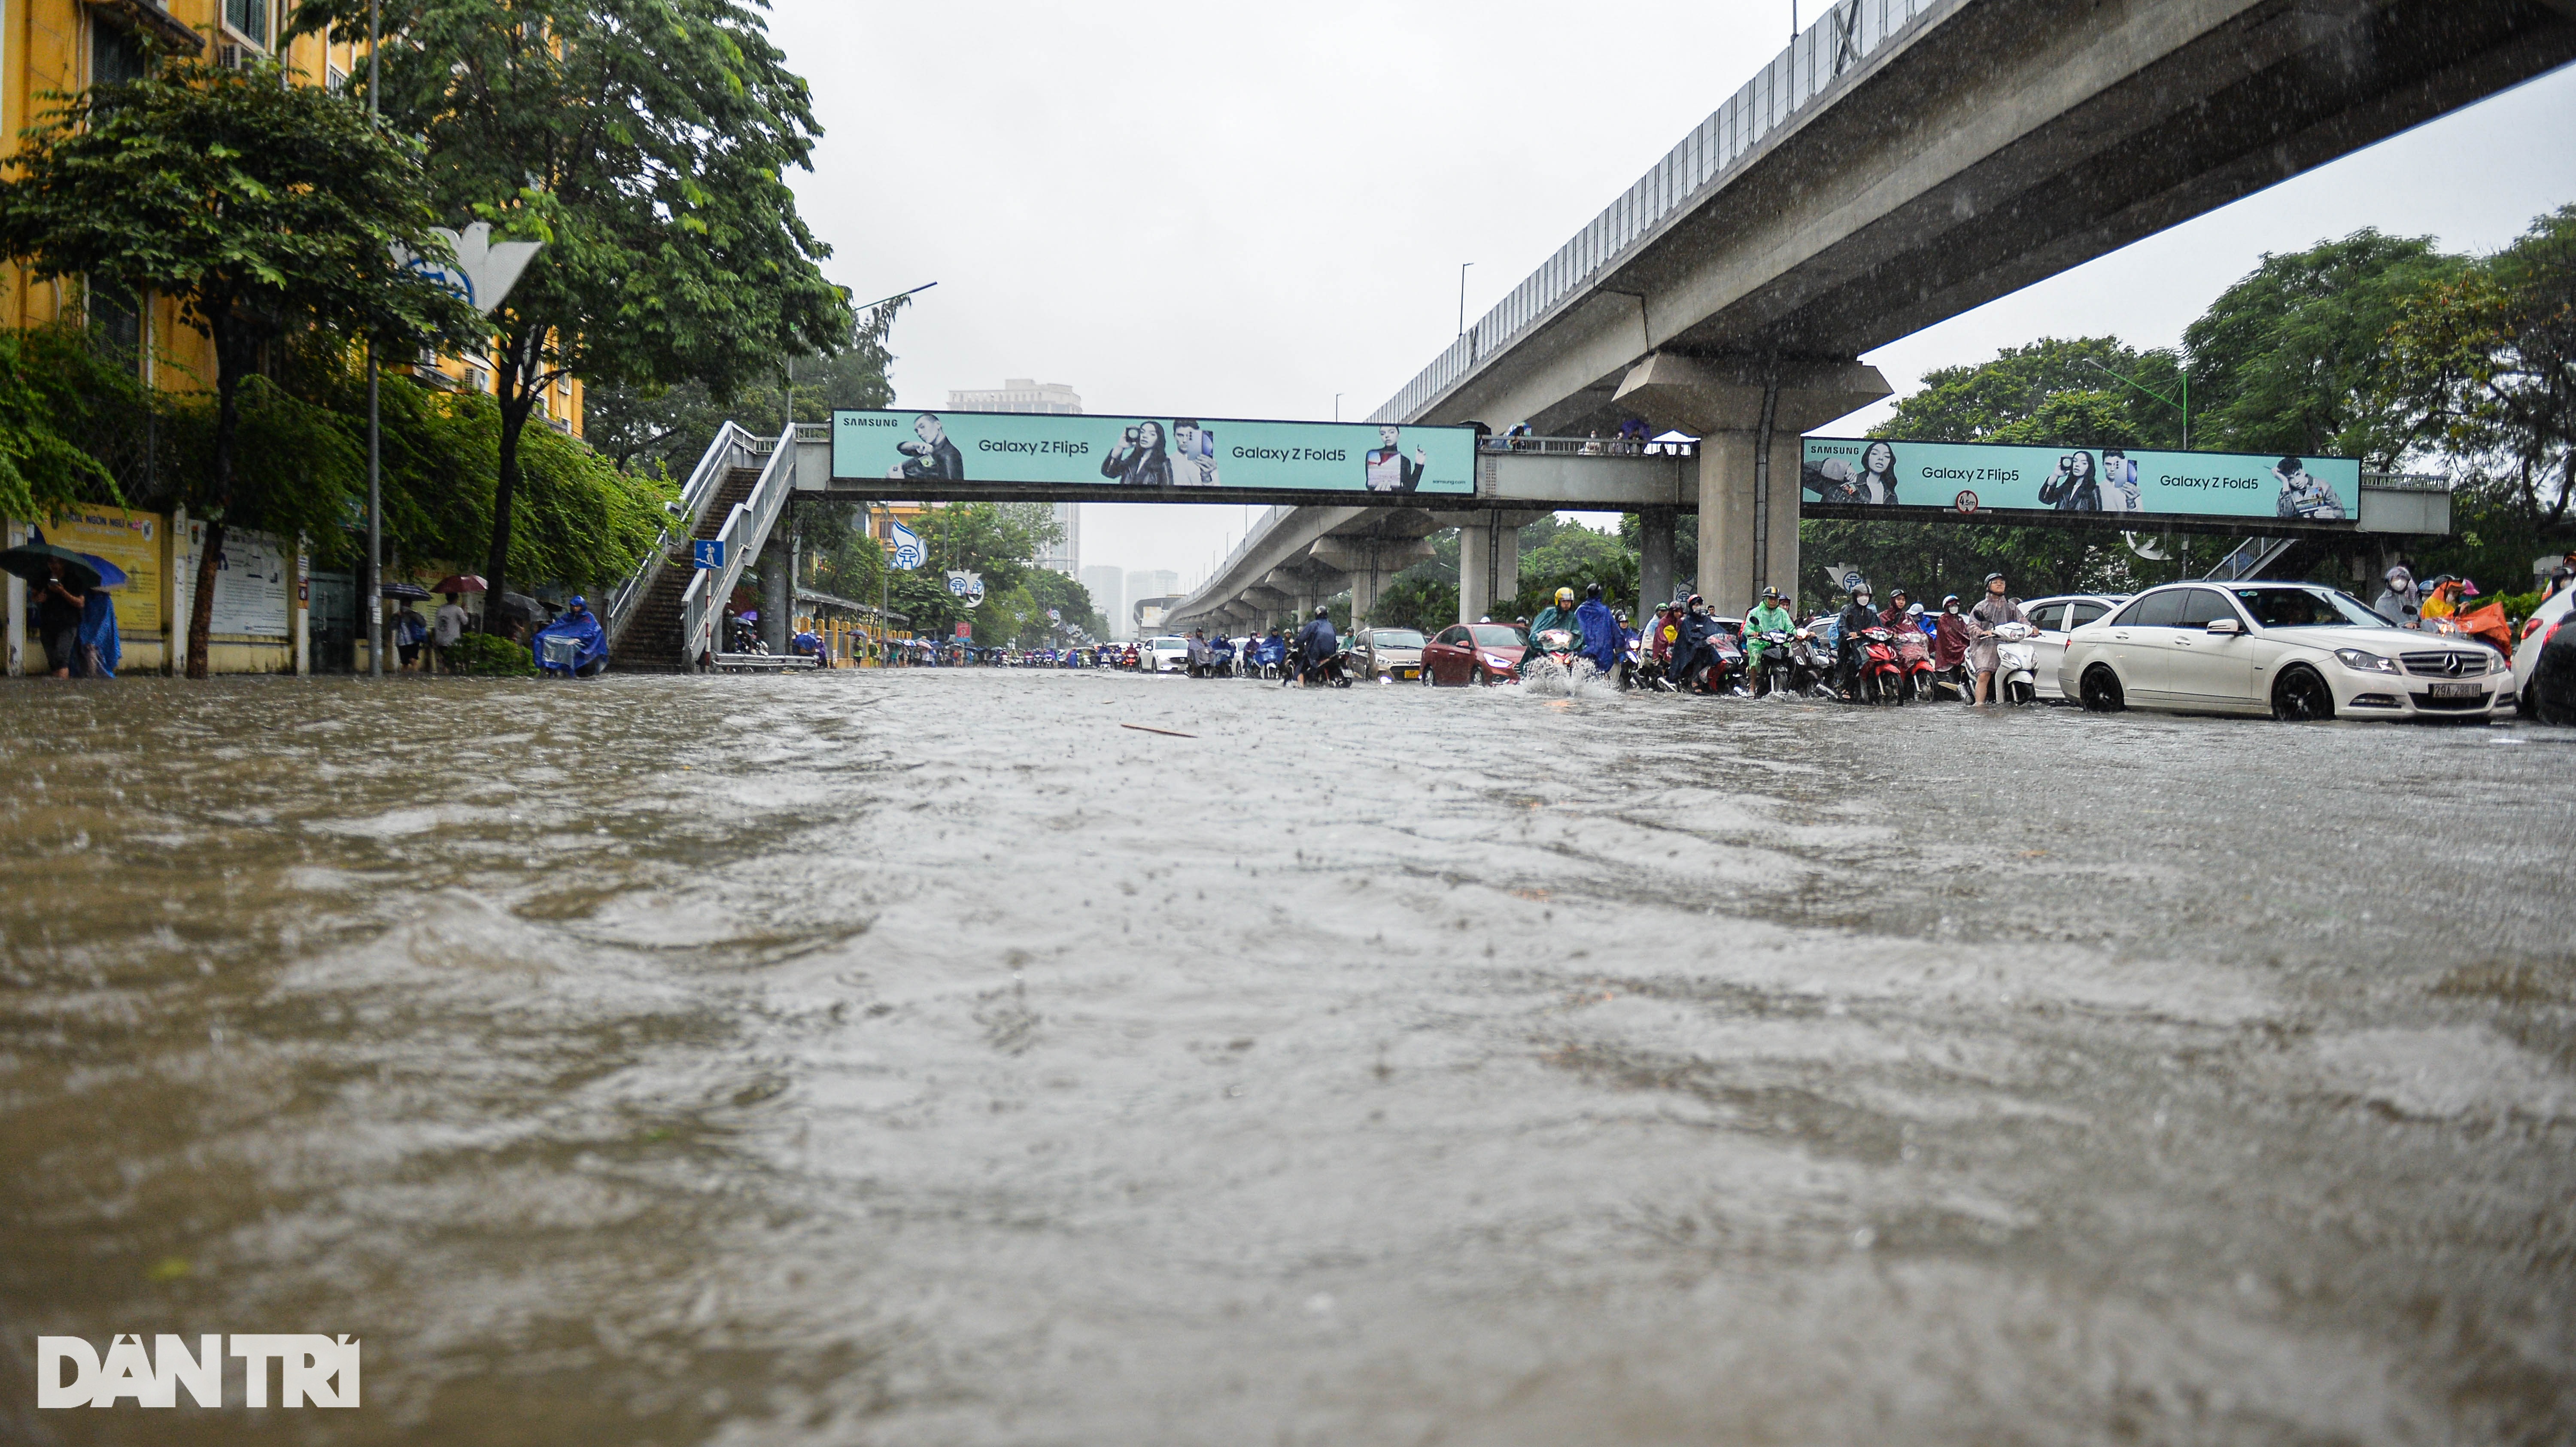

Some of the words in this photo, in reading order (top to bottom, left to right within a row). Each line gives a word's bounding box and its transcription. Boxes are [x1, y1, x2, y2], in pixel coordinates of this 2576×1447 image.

[844, 418, 897, 427] SAMSUNG
[979, 440, 1037, 455] Galaxy
[1041, 441, 1049, 453] Z
[1053, 441, 1088, 457] Flip5
[1233, 447, 1288, 462] Galaxy
[1292, 448, 1300, 459] Z
[1305, 449, 1346, 461] Fold5
[1811, 446, 1859, 455] SAMSUNG
[1922, 467, 1973, 482] Galaxy
[1977, 469, 1984, 480] Z
[1988, 468, 2019, 484] Flip5
[2160, 475, 2210, 490] Galaxy
[2212, 477, 2219, 488] Z
[2223, 478, 2258, 489] Fold5
